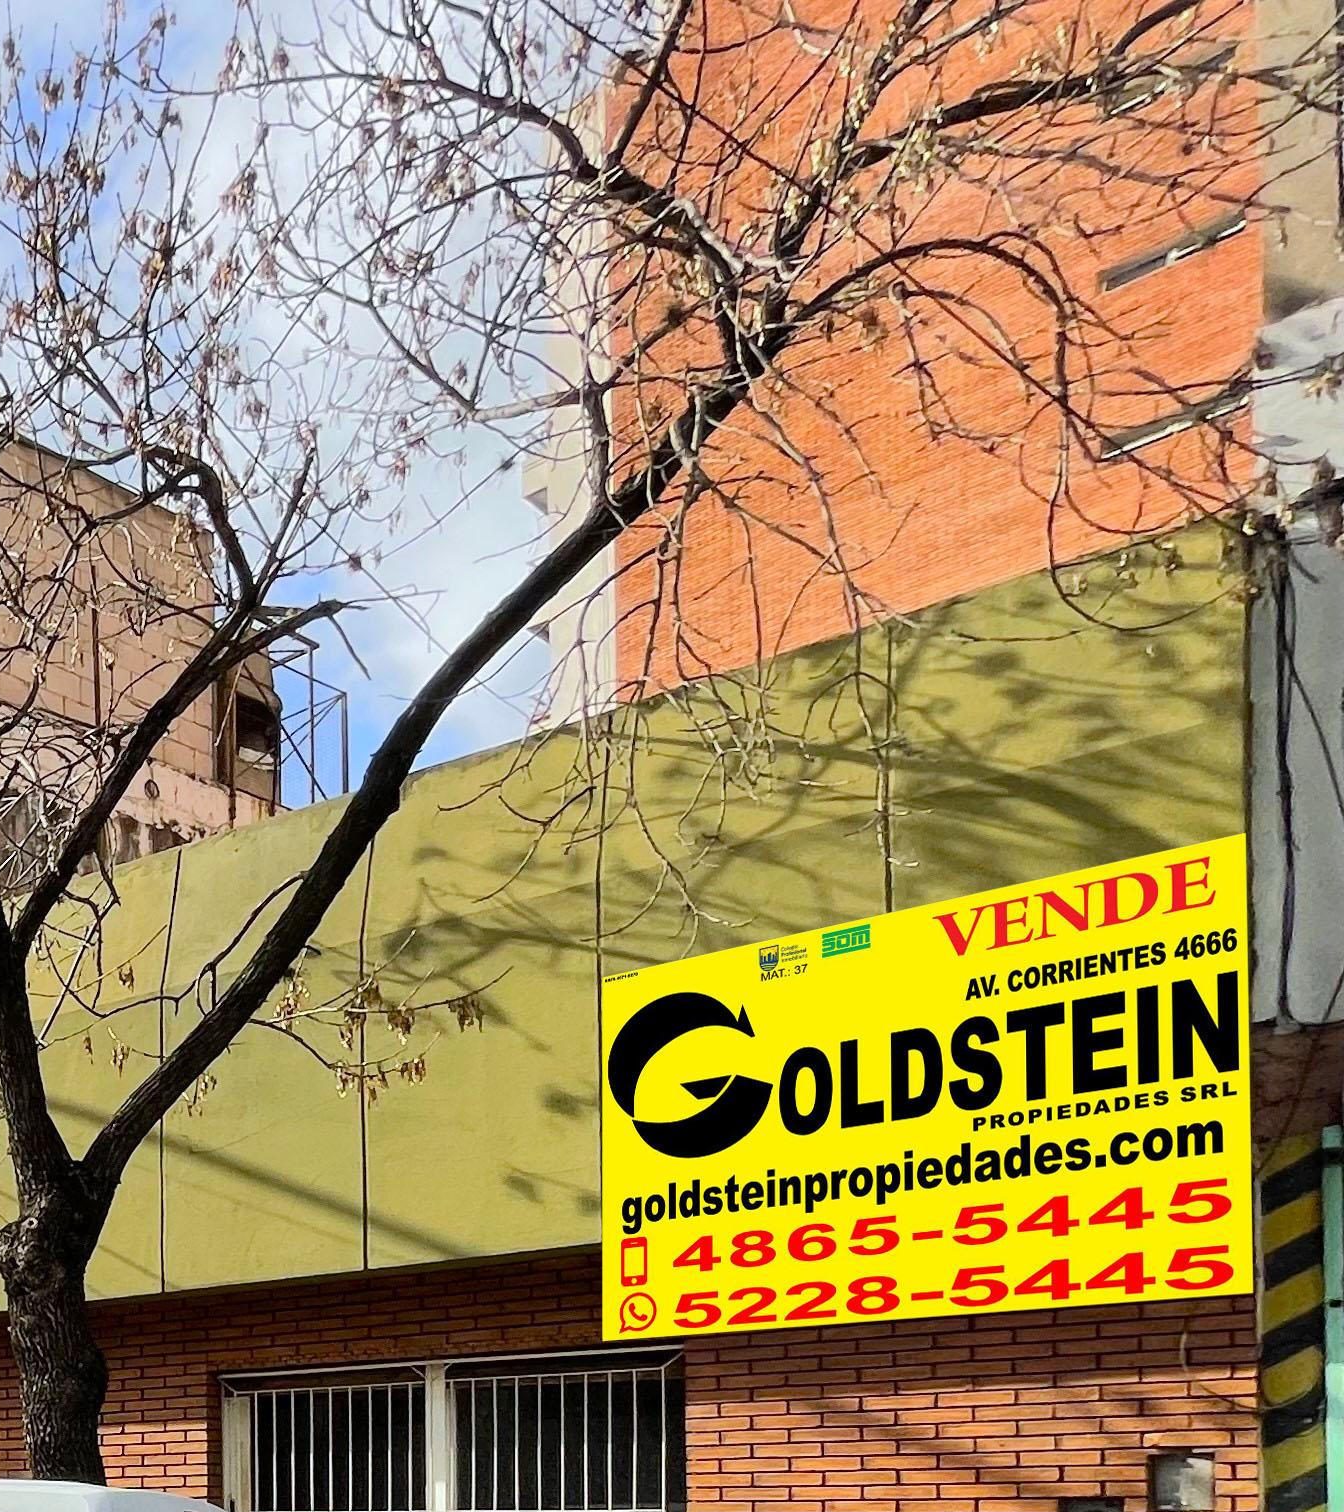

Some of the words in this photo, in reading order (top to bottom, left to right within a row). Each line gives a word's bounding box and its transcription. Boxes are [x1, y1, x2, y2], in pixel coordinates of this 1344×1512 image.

[932, 856, 1217, 957] VENDE
[760, 968, 791, 982] MAT.:
[794, 963, 808, 975] 37
[965, 974, 1001, 1001] AV.
[1007, 941, 1167, 993] CORRIENTES
[1174, 927, 1238, 961] 4666
[607, 970, 1240, 1159] GOLDSTEIN
[972, 1090, 1170, 1132] PROPIEDADES
[1180, 1081, 1238, 1103] SRL
[621, 1120, 1224, 1235] goldsteinpropiedades.com
[672, 1177, 1233, 1272] 4865-5445
[673, 1244, 1234, 1329] 5228-5445
